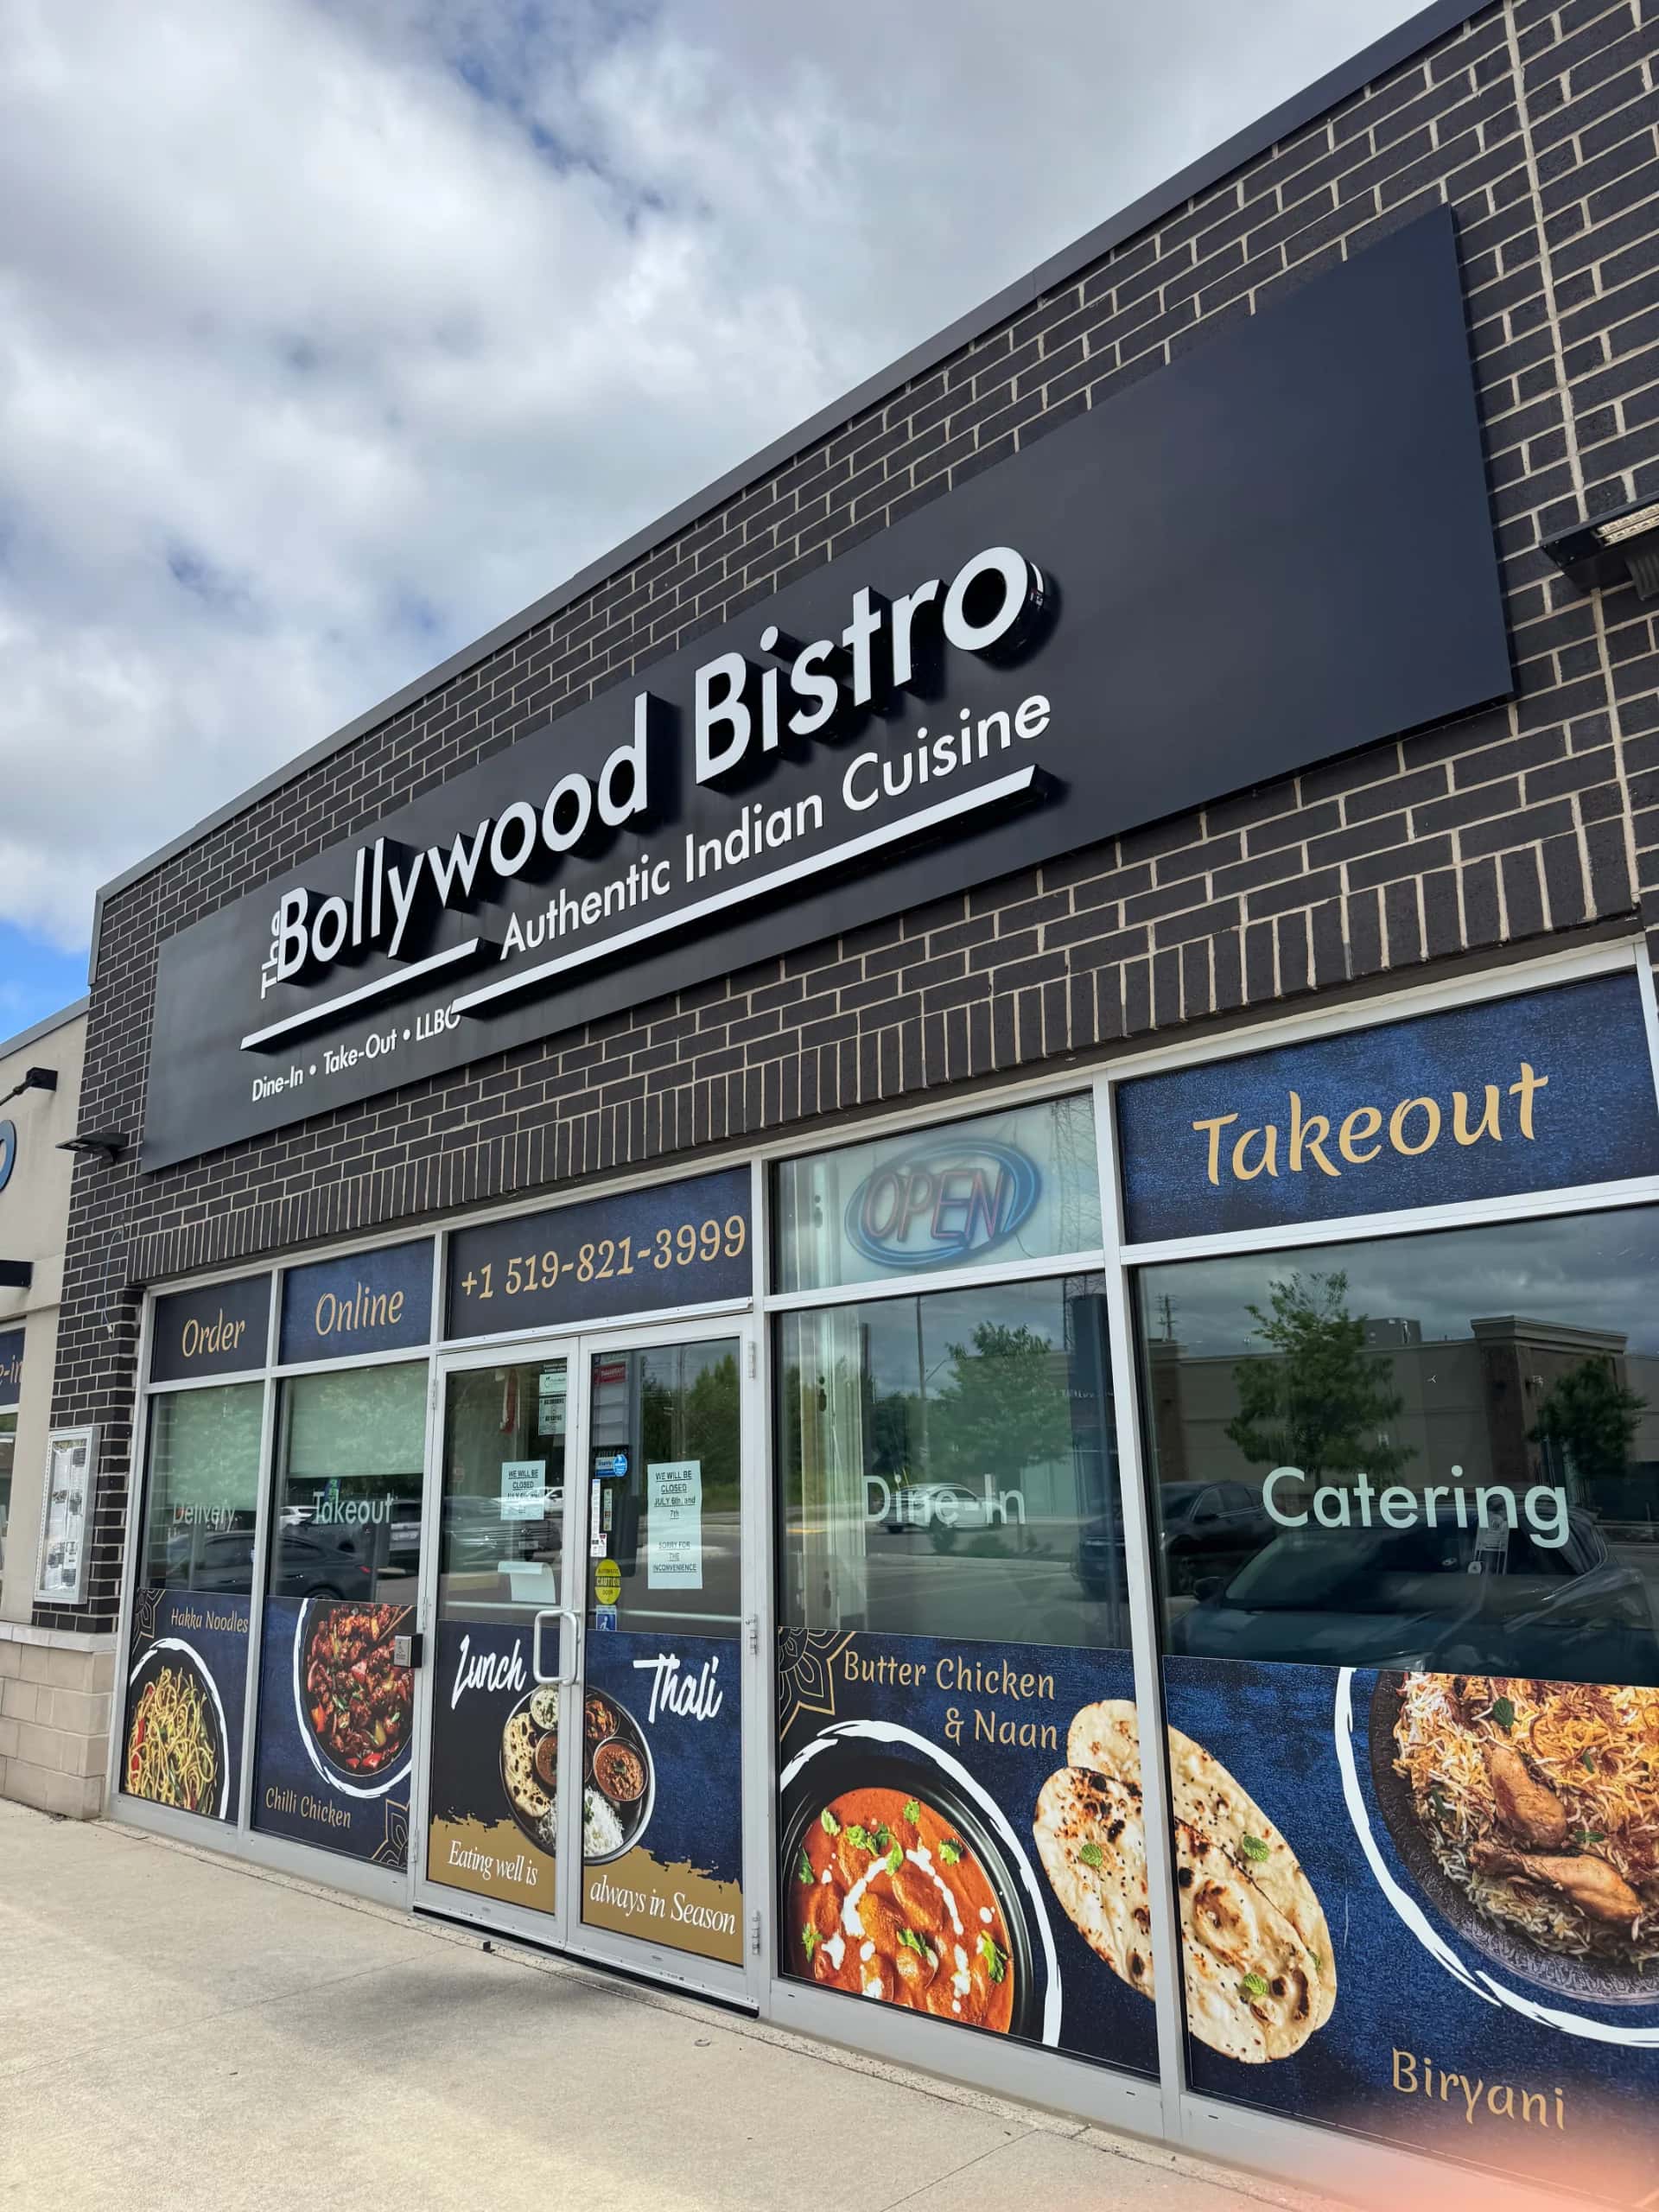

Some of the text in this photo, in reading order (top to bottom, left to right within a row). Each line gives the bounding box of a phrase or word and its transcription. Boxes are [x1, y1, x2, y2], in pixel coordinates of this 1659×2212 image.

[277, 546, 1028, 959] Bollywood Bistro
[500, 695, 1051, 960] Authentic Indian Cuisine
[252, 1066, 303, 1102] Dine-In
[324, 1030, 397, 1075] Take-Out
[1192, 1062, 1549, 1185] Takeout
[866, 1168, 1004, 1243] OPEN
[461, 1215, 746, 1300] +1 519-821-3999
[182, 1309, 245, 1357] Order
[315, 1282, 404, 1336] Online
[173, 1501, 236, 1531] Delivery
[313, 1488, 393, 1524] Takeout
[661, 1484, 687, 1492] CLOSED
[863, 1473, 1026, 1524] Dine-In
[1262, 1465, 1570, 1548] Catering
[171, 1606, 249, 1633] Hakka Noodles
[451, 1634, 527, 1710] Lunch
[632, 1653, 723, 1724] Thali
[844, 1649, 1055, 1700] Butter Chicken
[944, 1707, 1058, 1751] & Naan
[265, 1786, 351, 1828] Chilli Chicken
[448, 1840, 538, 1886] Eating well is
[590, 1875, 736, 1936] always in Season
[1392, 2047, 1565, 2130] Biryani
